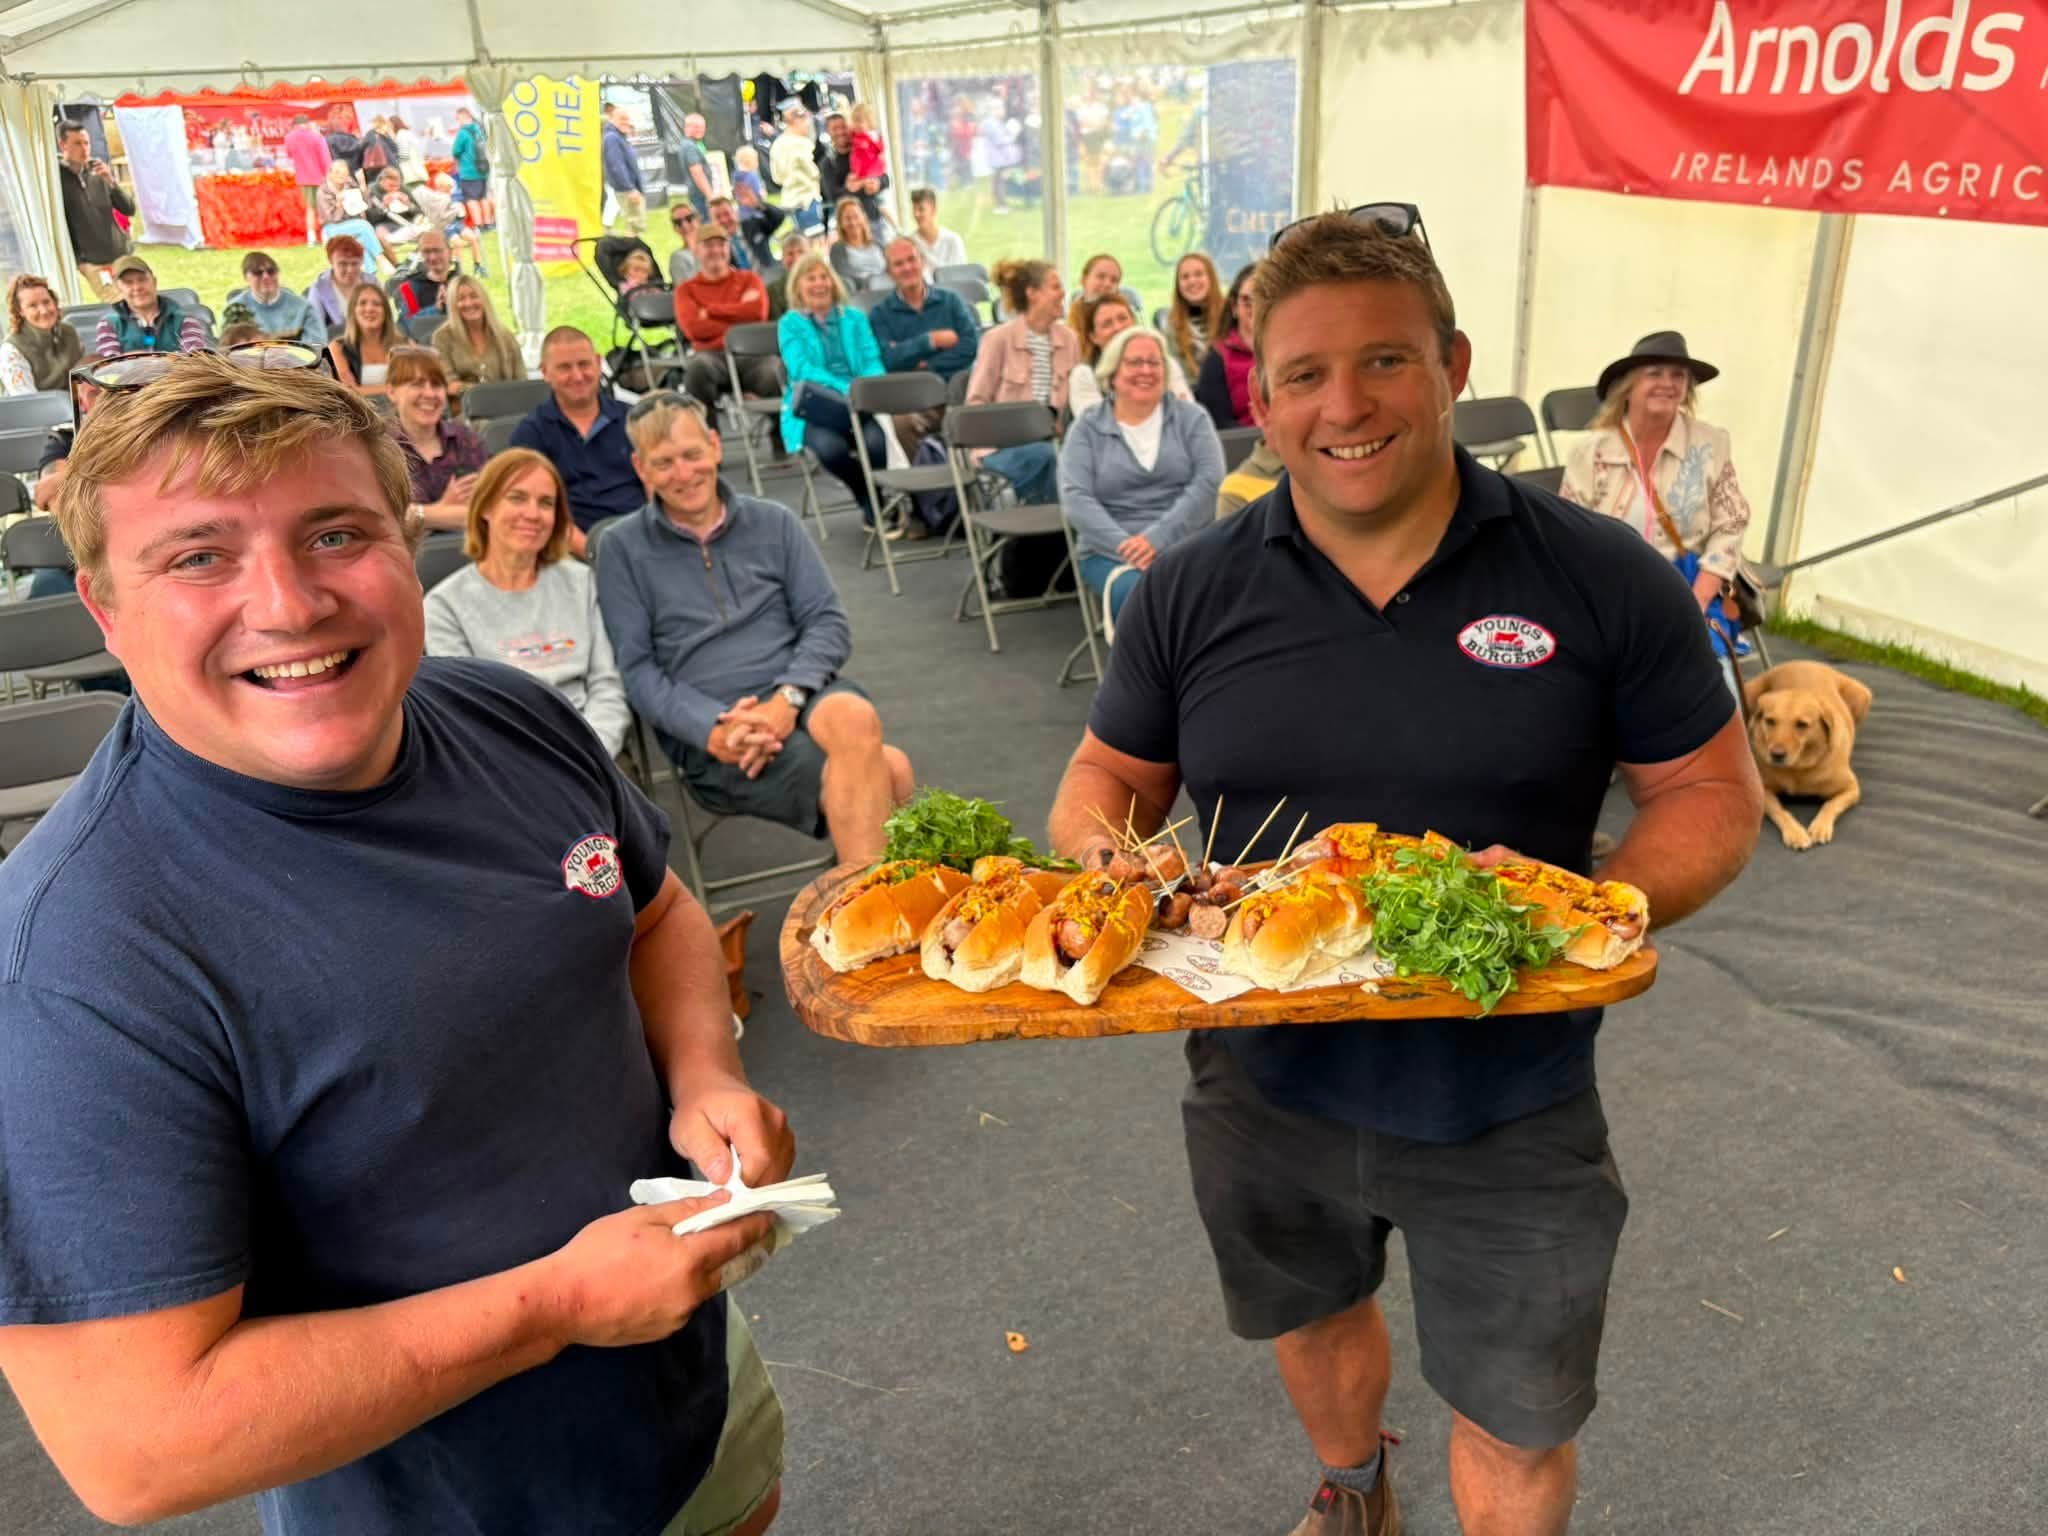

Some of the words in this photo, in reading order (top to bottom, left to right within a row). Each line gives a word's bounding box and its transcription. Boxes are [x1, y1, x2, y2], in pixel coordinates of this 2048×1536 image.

[1677, 0, 2024, 95] Arnolds
[1670, 151, 1863, 192] IRELANDS
[1887, 161, 2044, 201] AGRIC
[1474, 620, 1543, 641] YOUNGS
[1466, 639, 1548, 664] BURGERS
[567, 838, 610, 873] YOUNGS
